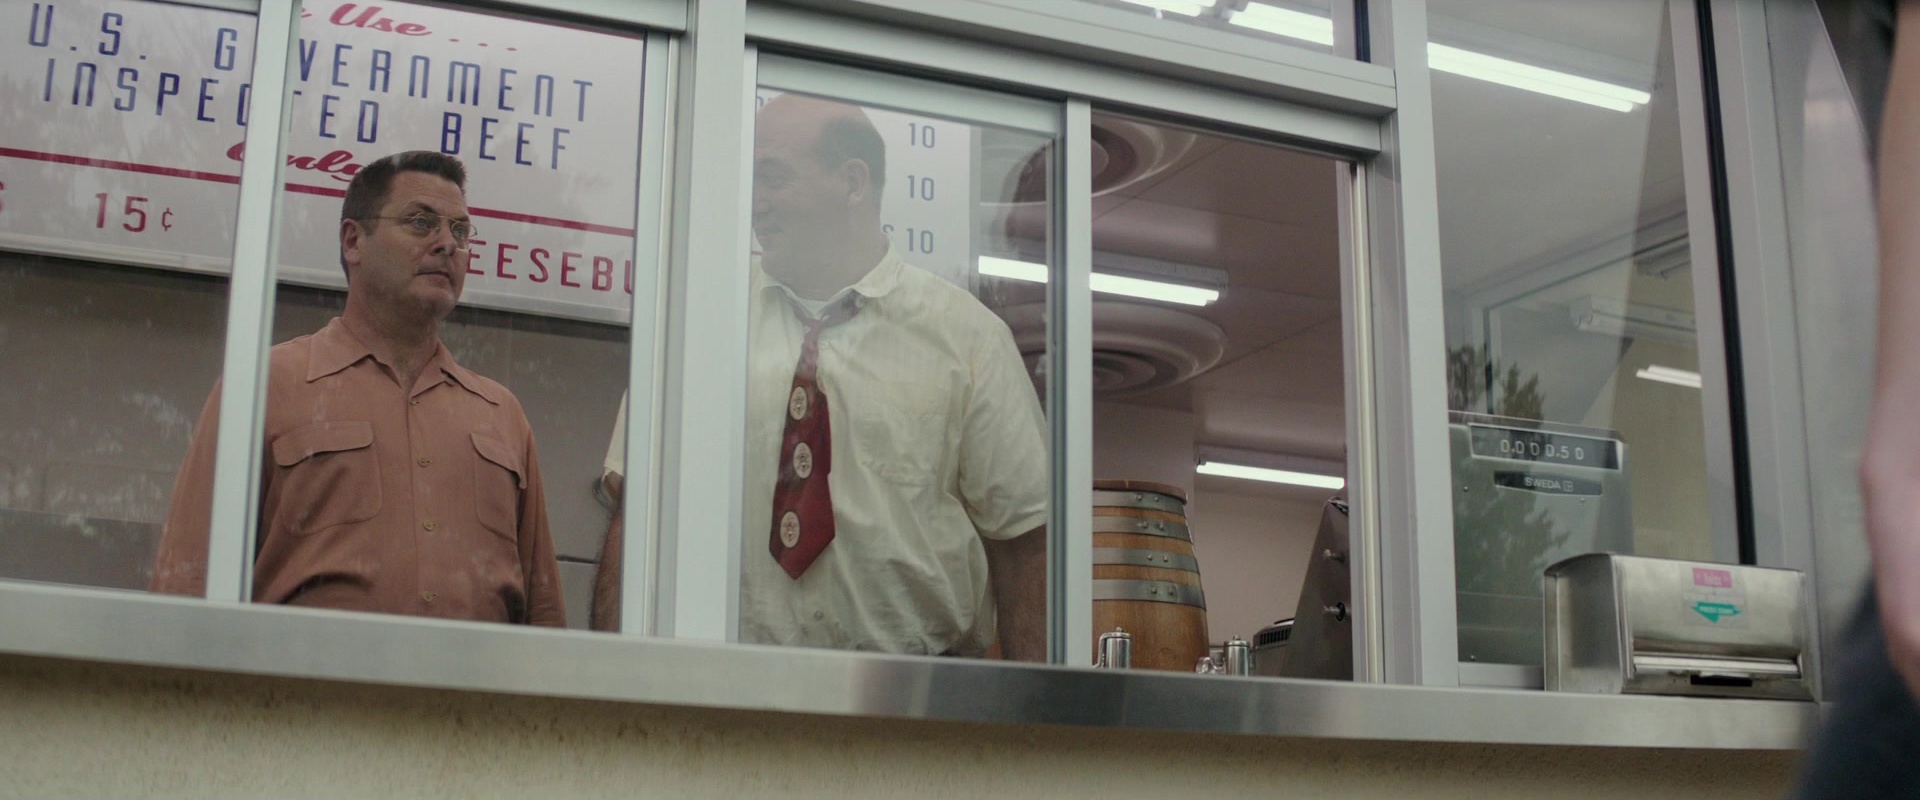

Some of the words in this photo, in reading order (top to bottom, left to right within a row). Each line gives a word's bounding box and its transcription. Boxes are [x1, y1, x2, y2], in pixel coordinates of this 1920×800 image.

[28, 2, 147, 60] U.S.
[213, 27, 593, 123] GVERNMENT
[440, 111, 571, 171] BEEF
[908, 122, 936, 149] 10
[907, 174, 935, 201] 10
[906, 227, 934, 255] 10
[1523, 476, 1562, 490] SWEDA
